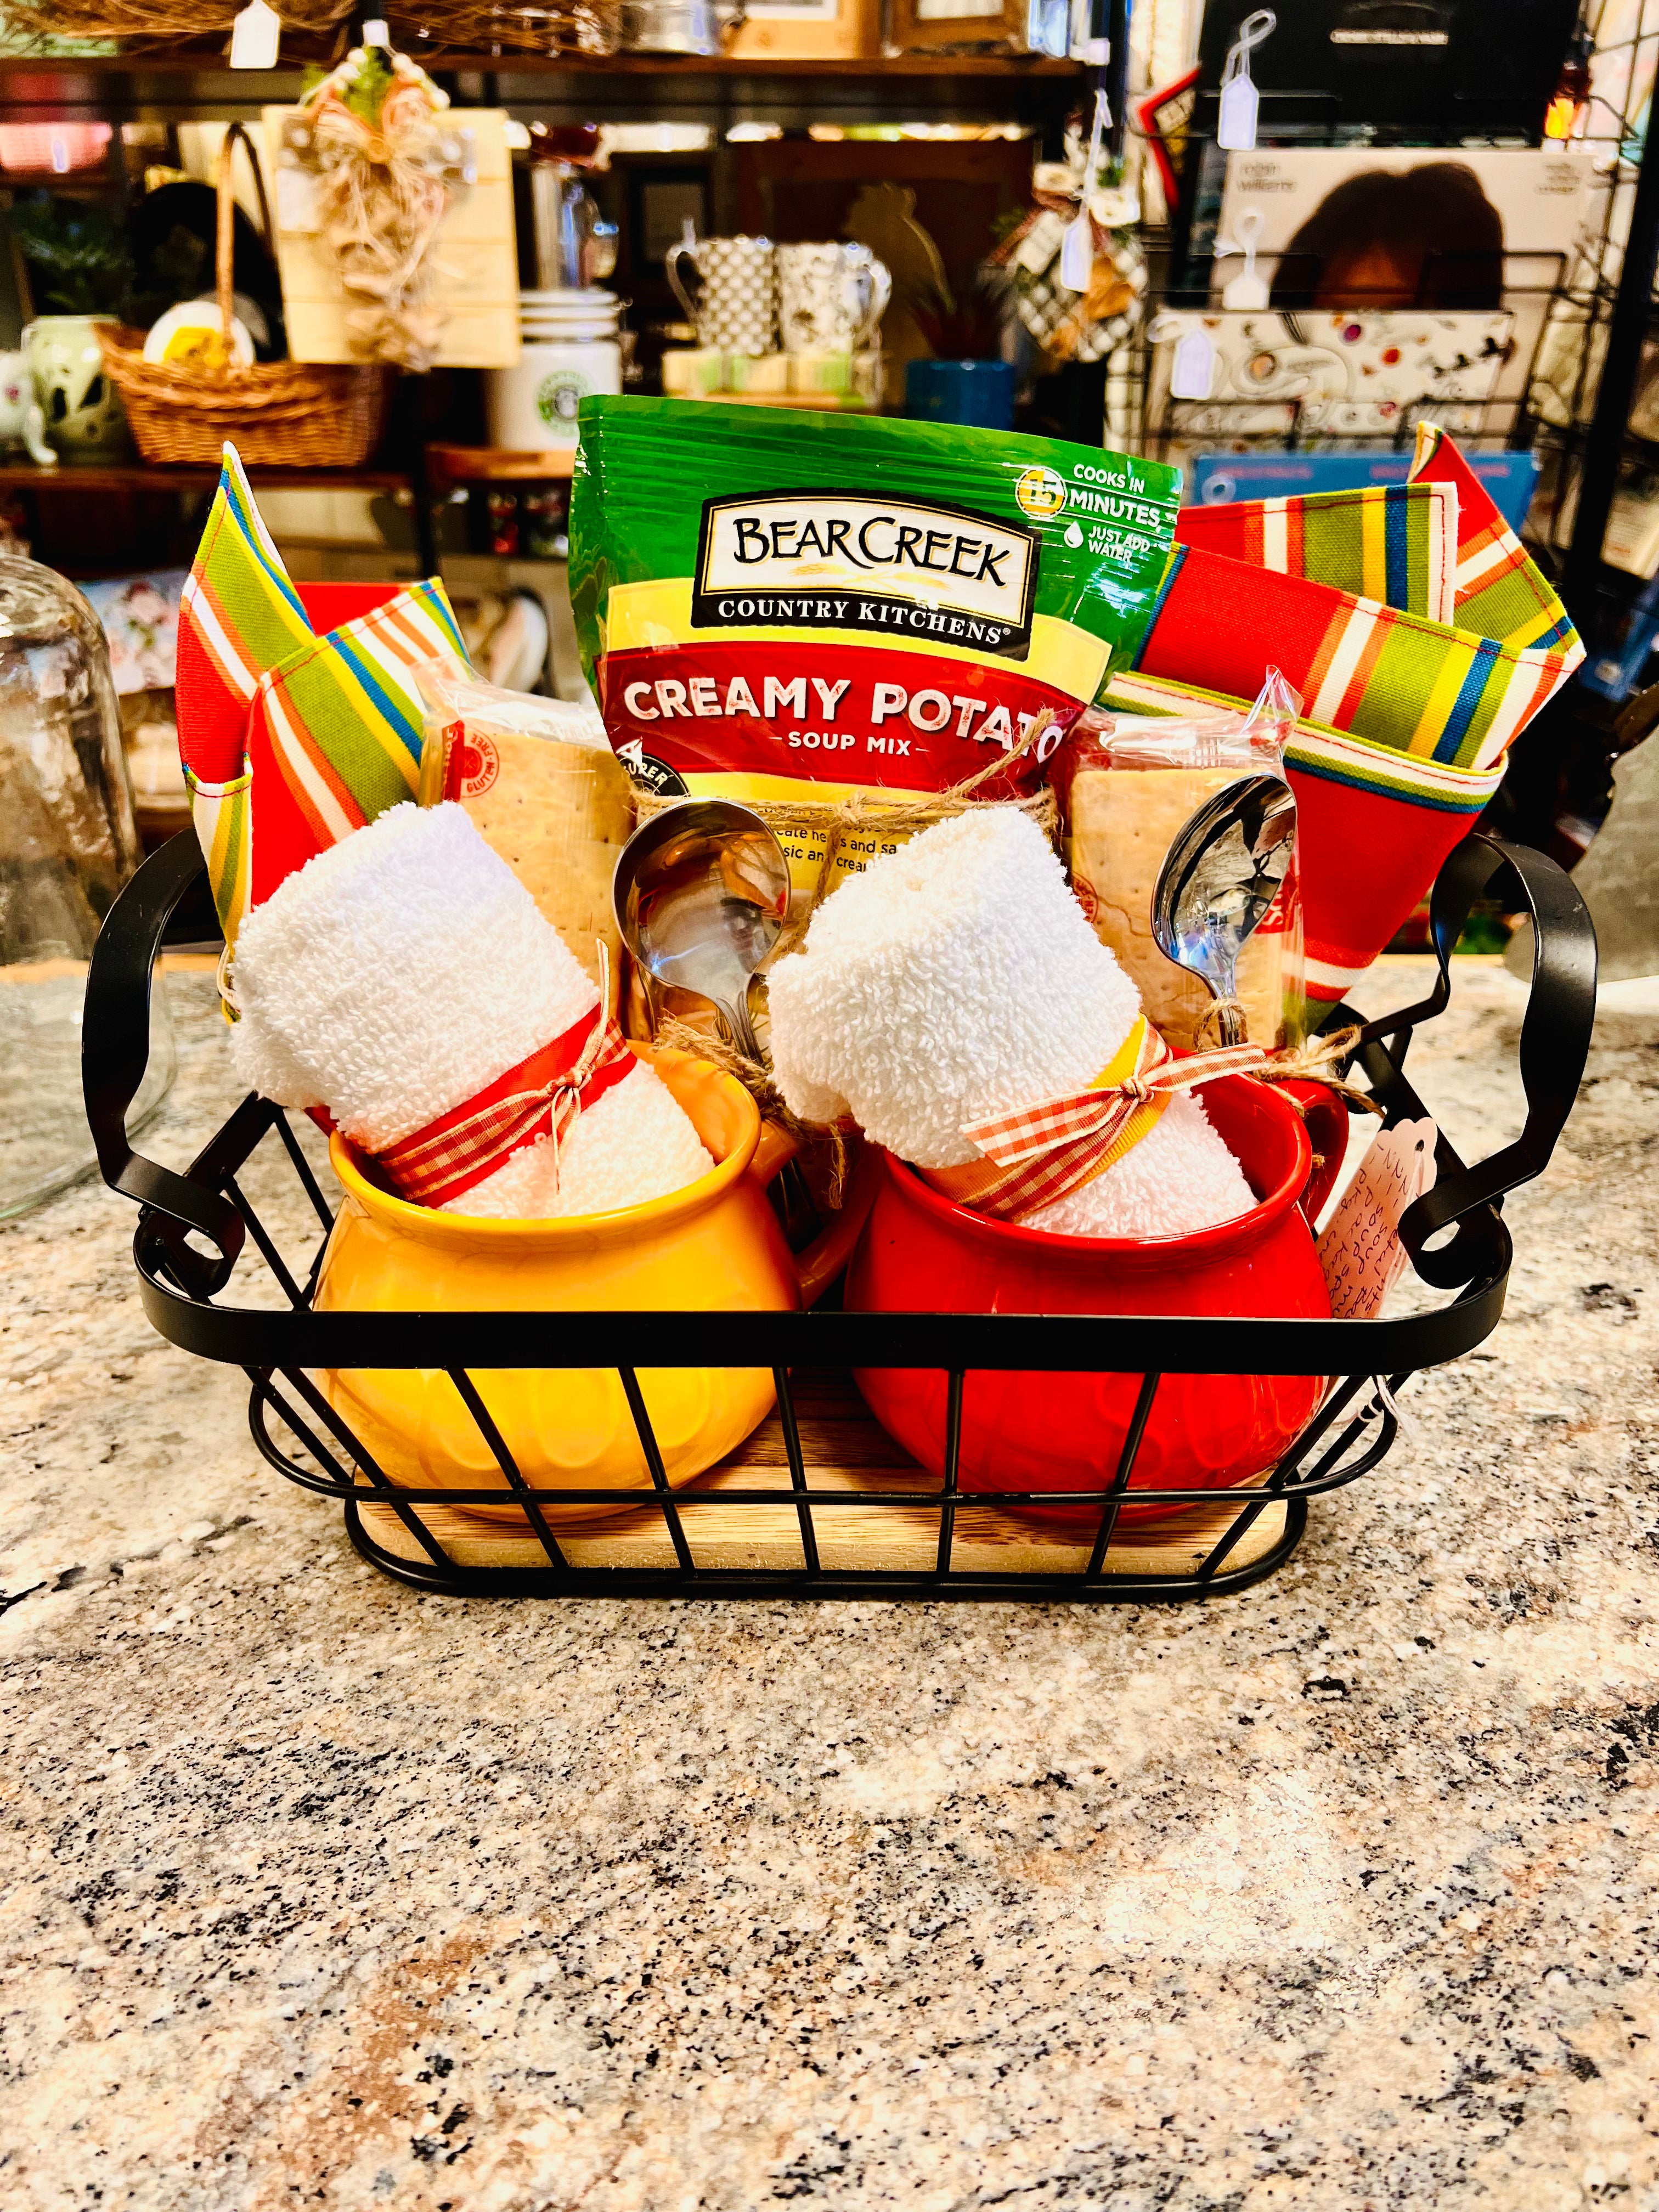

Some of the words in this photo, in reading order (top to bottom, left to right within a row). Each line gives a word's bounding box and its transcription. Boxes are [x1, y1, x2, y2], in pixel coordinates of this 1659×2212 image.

[1073, 464, 1126, 489] COOKS
[1130, 477, 1145, 494] IN
[1069, 488, 1160, 527] MINUTES
[733, 517, 874, 569] BEAR
[858, 516, 1012, 587] CREEK
[1088, 526, 1122, 544] JUST
[1124, 533, 1150, 552] ADD
[1088, 539, 1132, 562] WATER
[718, 599, 850, 619] COUNTRY
[624, 676, 851, 720] CREAMY
[788, 731, 856, 750] SOUP
[866, 737, 913, 756] MIX
[808, 850, 824, 862] an
[850, 840, 876, 853] and
[1353, 1201, 1383, 1256] soup
[1358, 1222, 1387, 1274] soup
